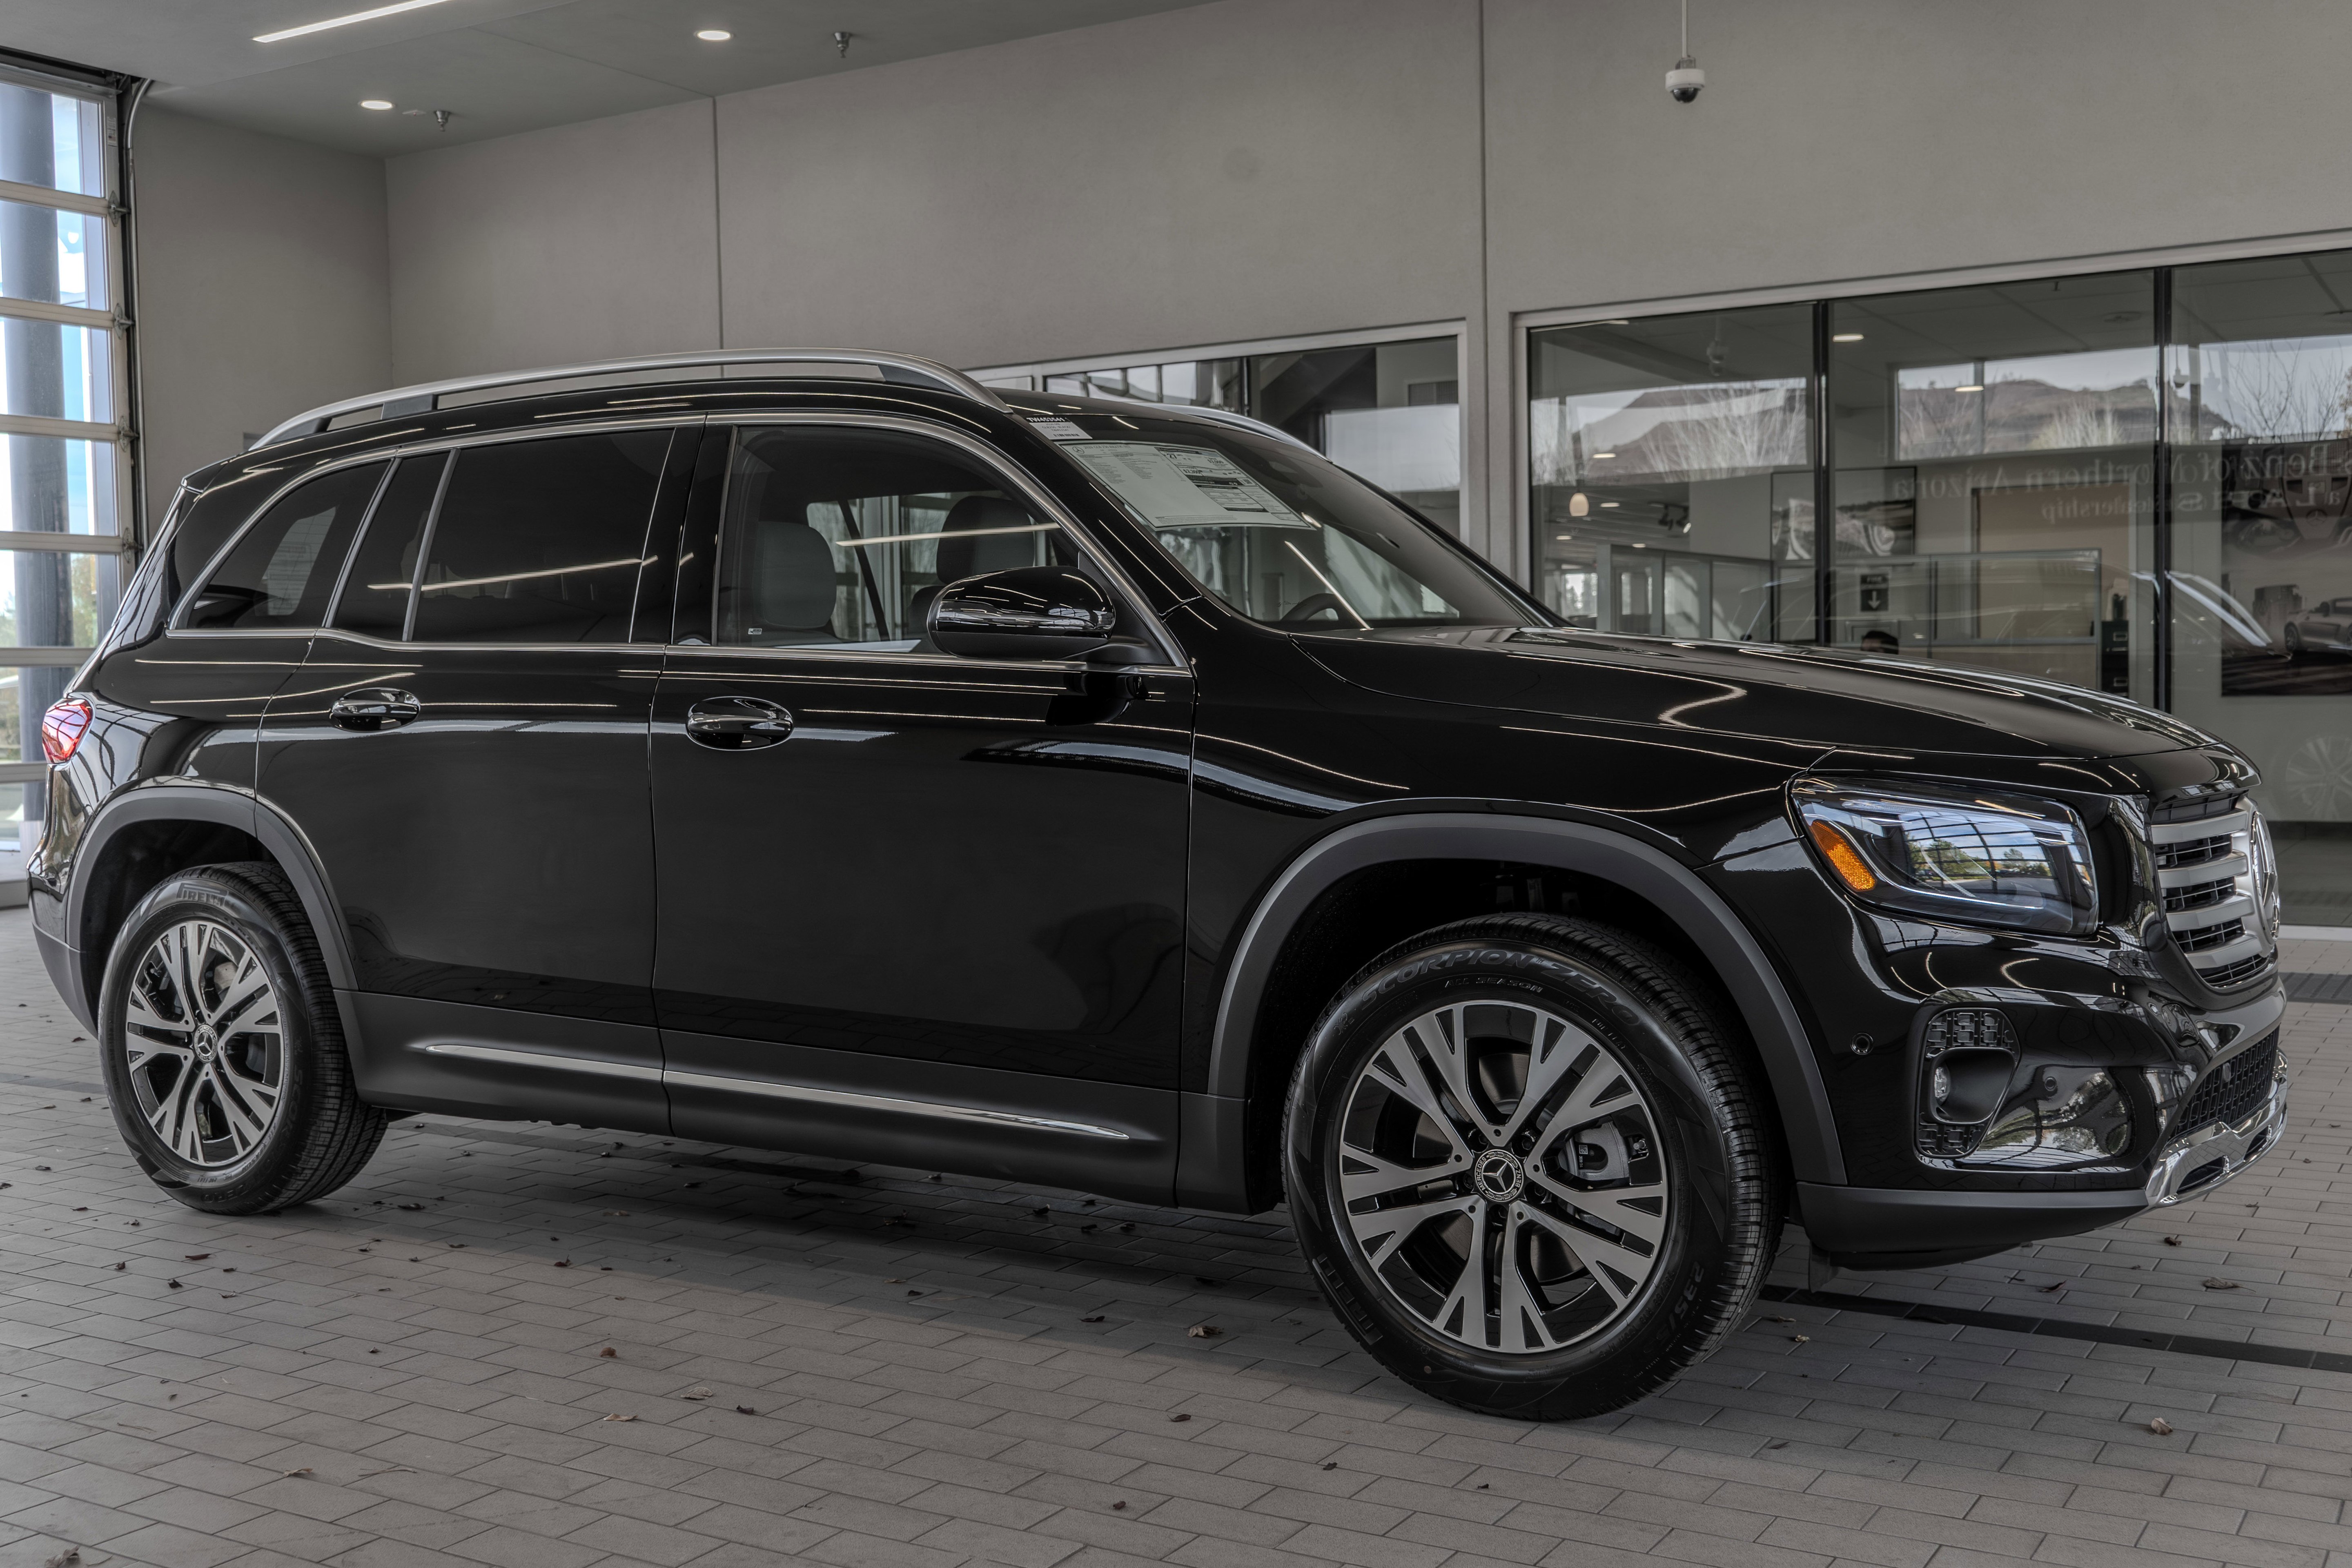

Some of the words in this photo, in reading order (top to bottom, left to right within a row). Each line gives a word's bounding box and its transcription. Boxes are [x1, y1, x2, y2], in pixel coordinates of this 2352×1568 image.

[177, 883, 228, 906] PIRELLI
[1361, 949, 1532, 1010] SCORPION
[1541, 962, 1640, 1026] ZERO
[1445, 978, 1470, 988] ALL
[1476, 976, 1544, 993] SEASON
[1476, 1156, 1487, 1191] MERCEDES
